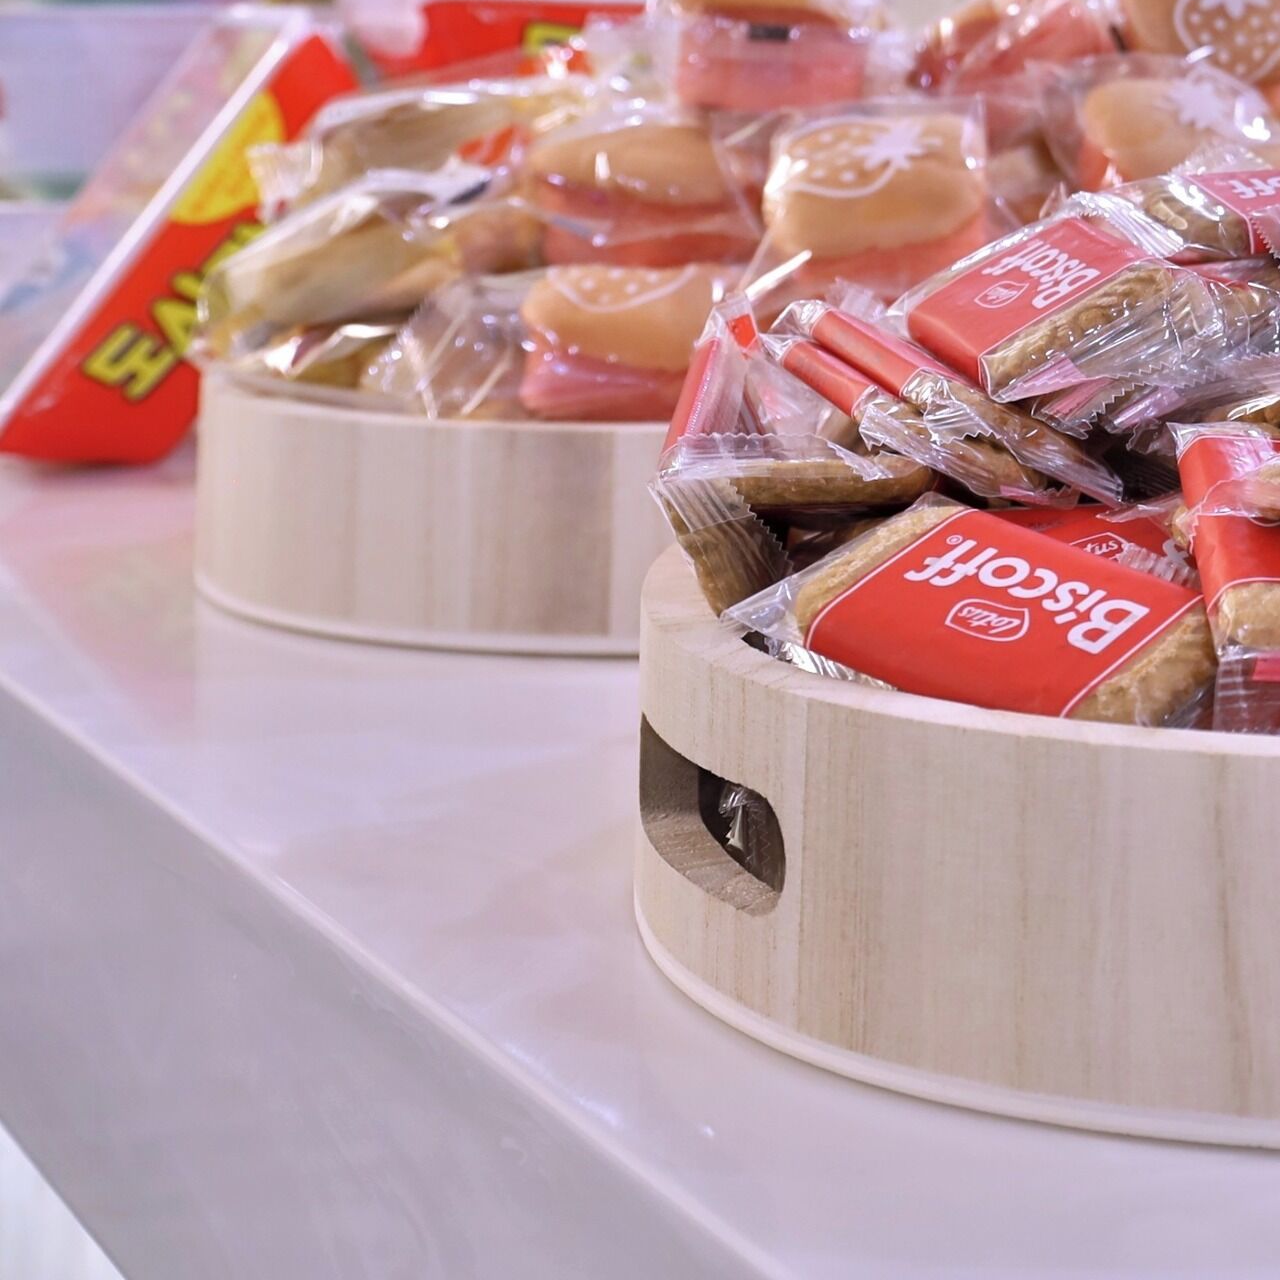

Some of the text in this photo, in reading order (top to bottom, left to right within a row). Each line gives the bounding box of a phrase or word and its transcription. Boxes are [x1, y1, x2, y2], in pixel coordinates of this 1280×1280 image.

[981, 238, 1102, 310] Biscoff
[903, 539, 1150, 655] Biscoff
[957, 605, 1021, 635] Lotus
